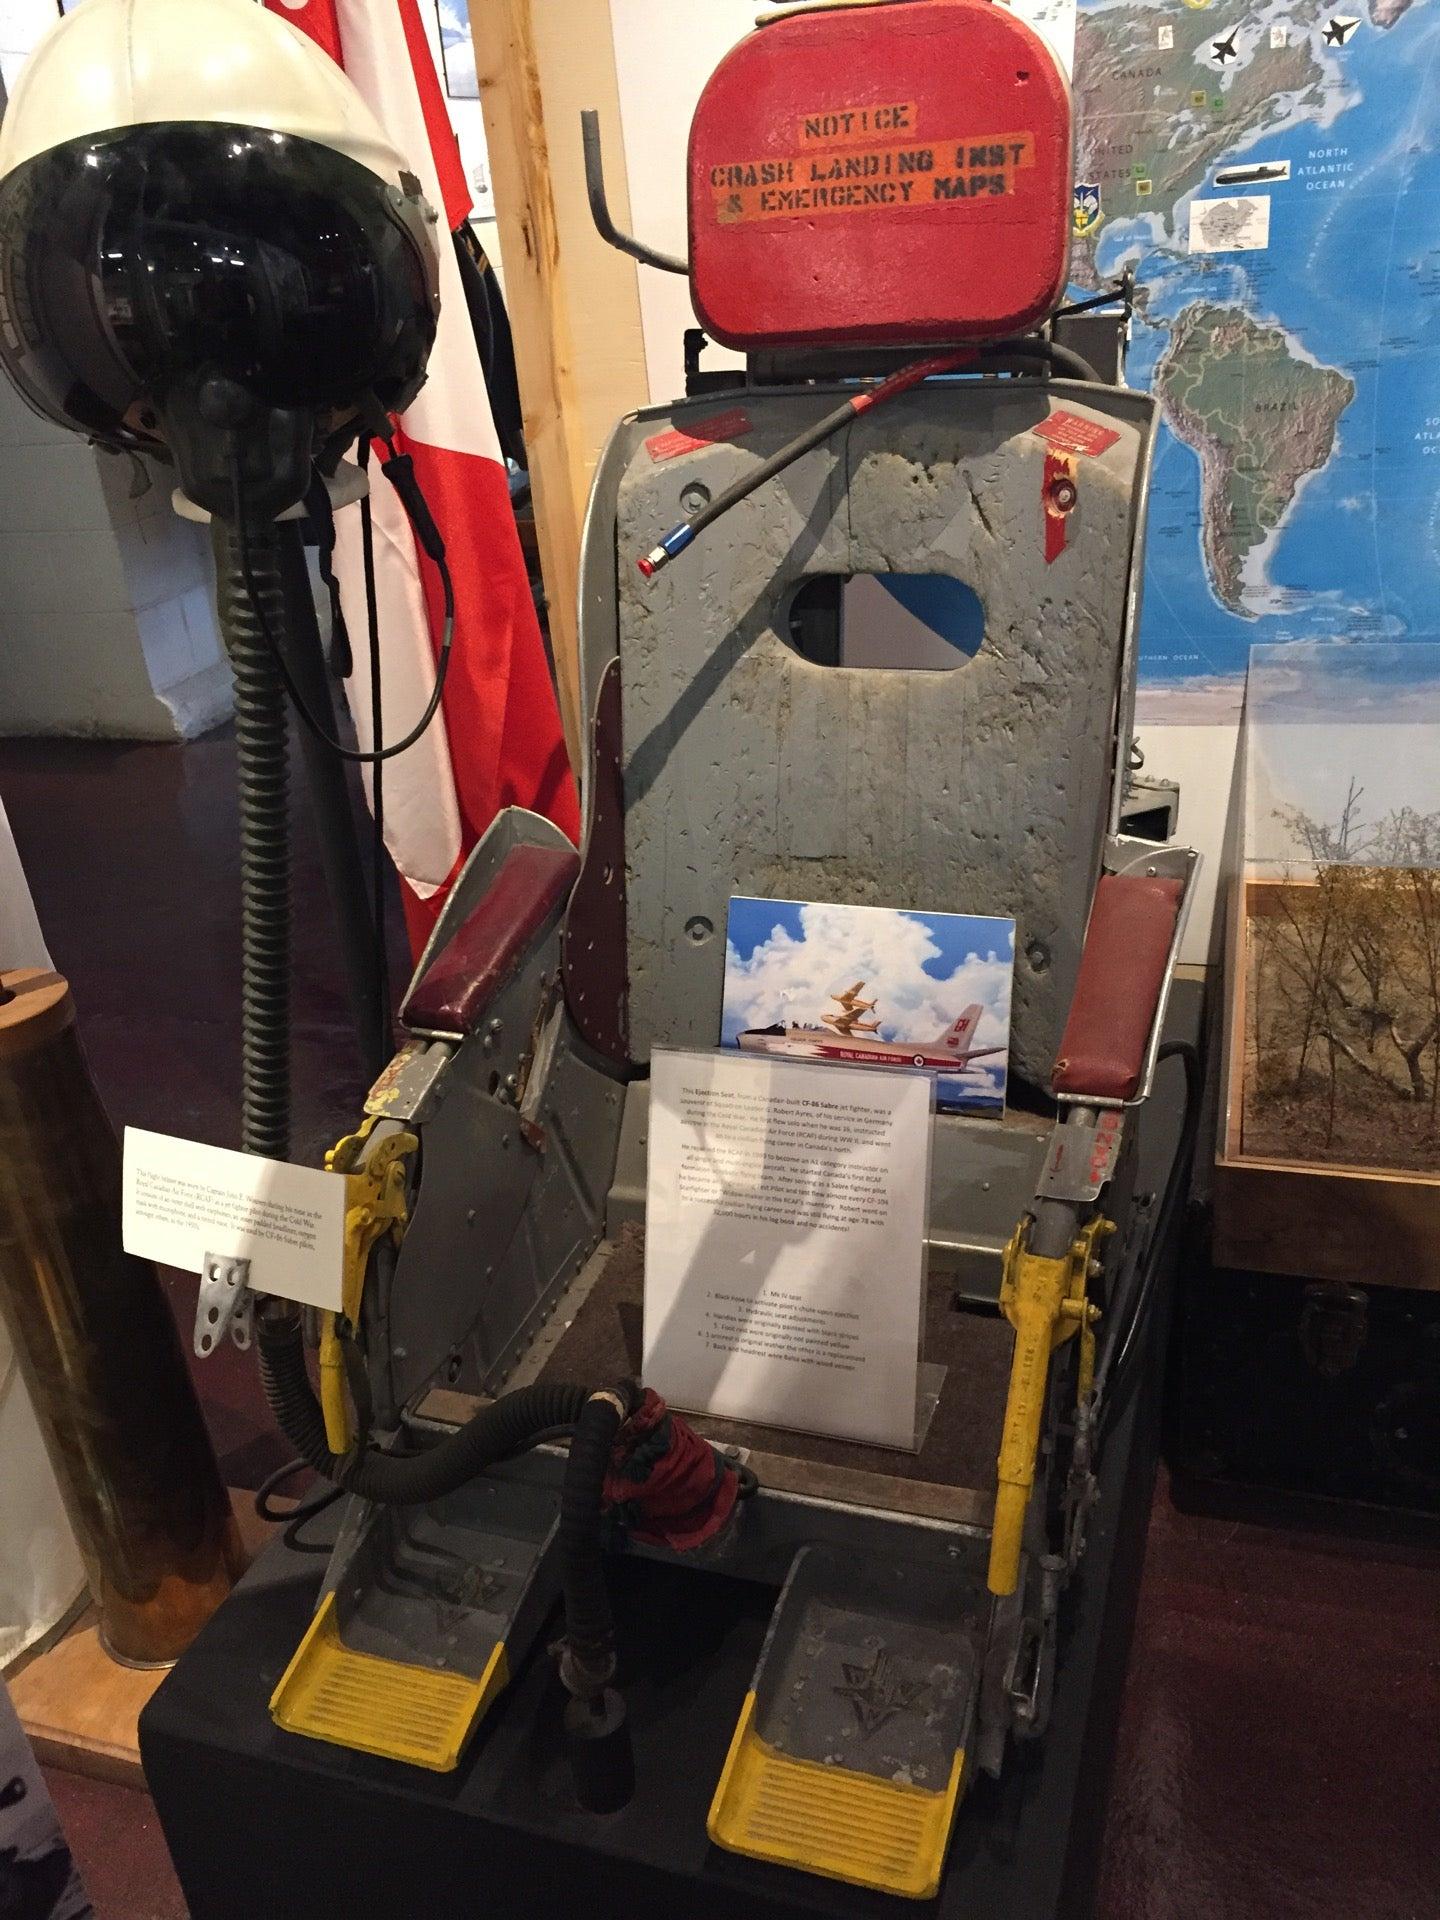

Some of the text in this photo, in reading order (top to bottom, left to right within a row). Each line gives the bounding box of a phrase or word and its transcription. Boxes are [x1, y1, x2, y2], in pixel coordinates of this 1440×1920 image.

[1112, 67, 1162, 81] CANADA
[804, 105, 909, 138] NOTICE
[1308, 147, 1348, 159] NORTH
[710, 161, 794, 188] CRASH
[809, 149, 935, 181] LANDING
[1297, 162, 1355, 175] ATLANTIC
[1305, 179, 1346, 191] OCEAN
[760, 181, 915, 212] EMERGENCY
[932, 174, 1007, 200] MAPS
[1255, 402, 1298, 412] BRAZIL
[1422, 446, 1440, 454] OC
